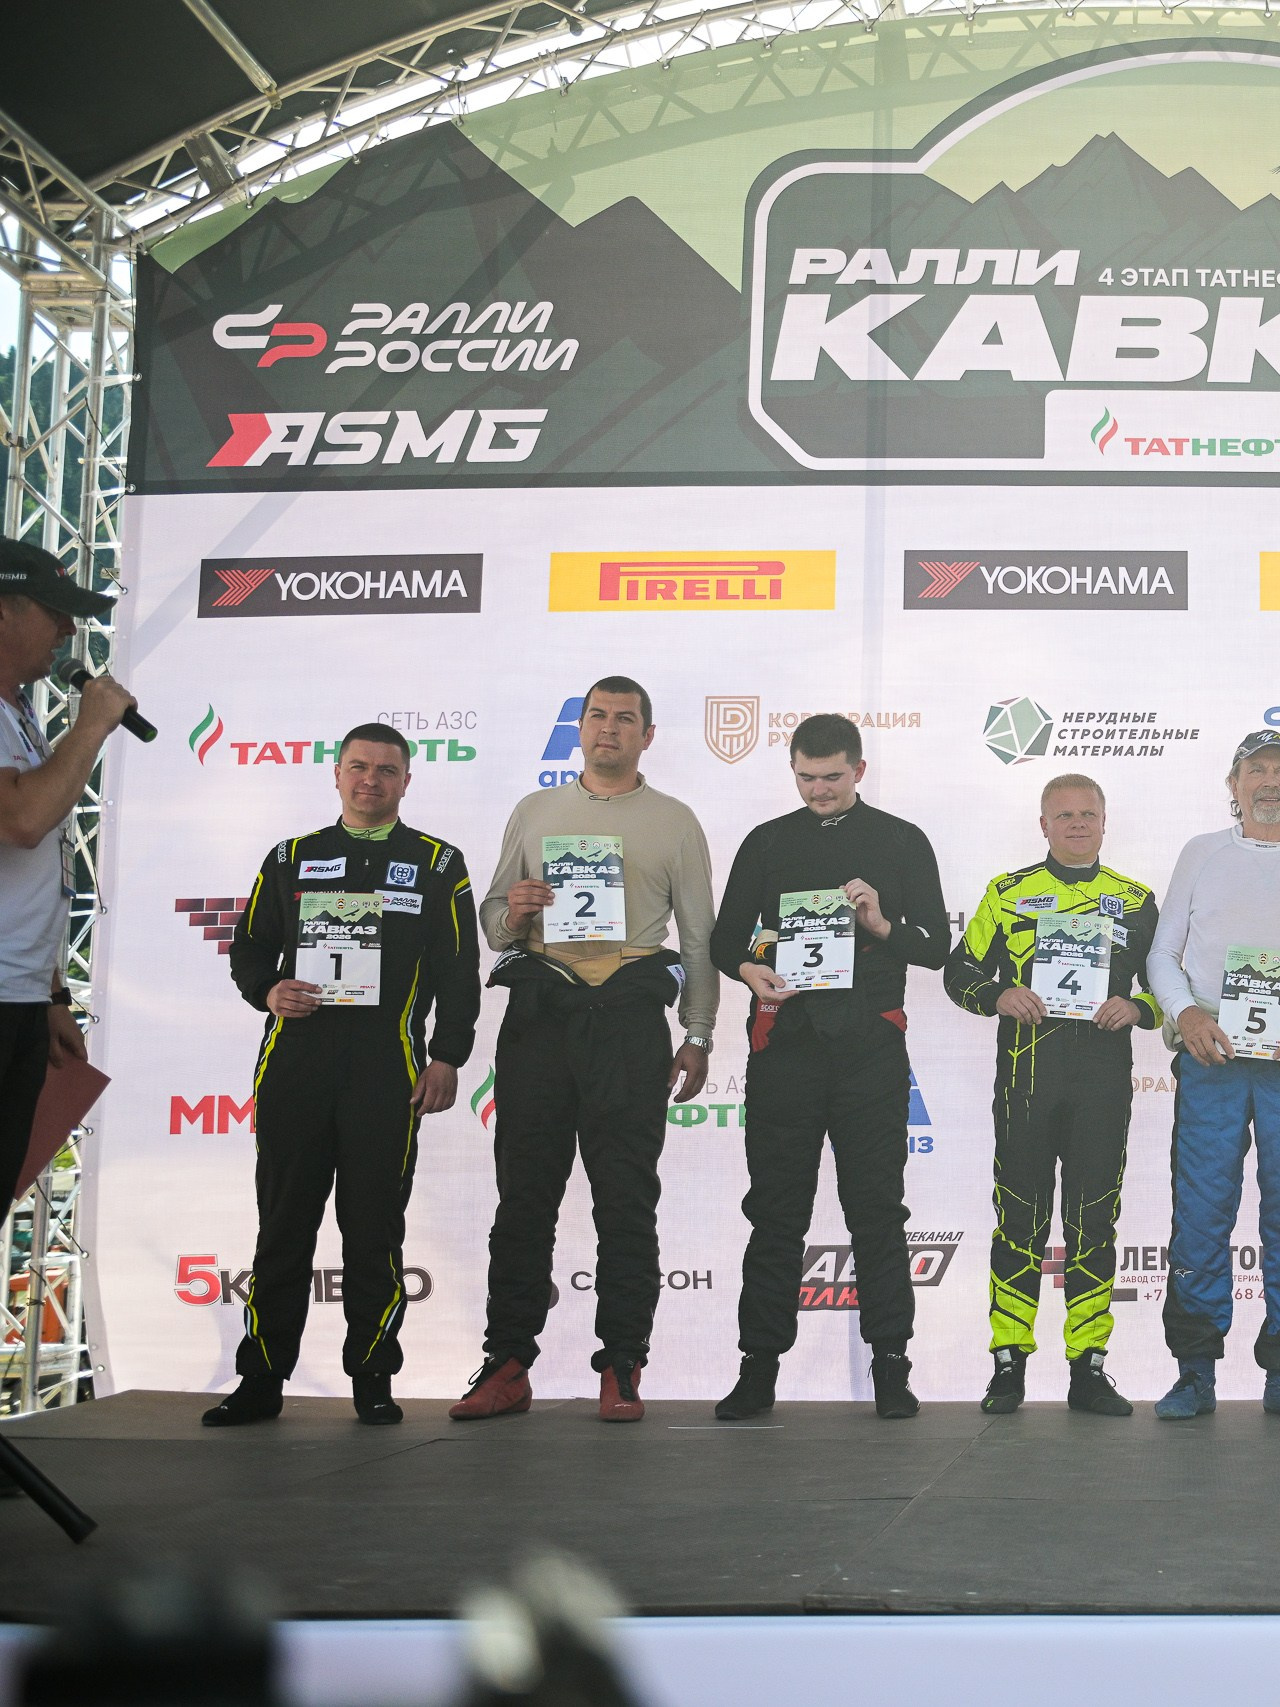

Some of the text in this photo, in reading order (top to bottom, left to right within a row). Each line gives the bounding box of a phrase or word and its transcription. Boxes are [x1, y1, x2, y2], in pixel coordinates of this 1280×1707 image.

[788, 248, 1080, 286] РАЛЛИ
[1098, 268, 1115, 287] 4
[1120, 268, 1189, 288] ЭТАП
[342, 301, 554, 335] РАЛЛИ
[325, 338, 579, 374] РОССИИ
[247, 408, 549, 468] ASMG
[275, 570, 468, 601] YOKOHAMA
[599, 560, 786, 601] PIRELLI
[979, 564, 1175, 596] YOKOHAMA
[377, 710, 478, 731] СЕТЬ АЗС
[768, 712, 921, 729] КОРАЦИЯ
[1062, 711, 1157, 724] НЕРУДНЫЕ
[1057, 728, 1200, 741] СТРОИТЕЛЬНЫЕ
[230, 738, 477, 766] ТАТНТЬ
[1053, 744, 1165, 758] МАТЕРИАЛЫ
[547, 865, 620, 876] КАВКАЗ
[574, 891, 597, 918] 2
[302, 925, 378, 935] КАВКАЗ
[781, 916, 850, 929] КАВКАЗ
[802, 942, 824, 968] 3
[1038, 942, 1107, 955] КАВКАЗ
[329, 953, 343, 981] 1
[1057, 969, 1082, 996] 4
[1244, 1006, 1267, 1035] 5
[1120, 1275, 1148, 1284] ЗАВОД
[1143, 1290, 1163, 1301] +7
